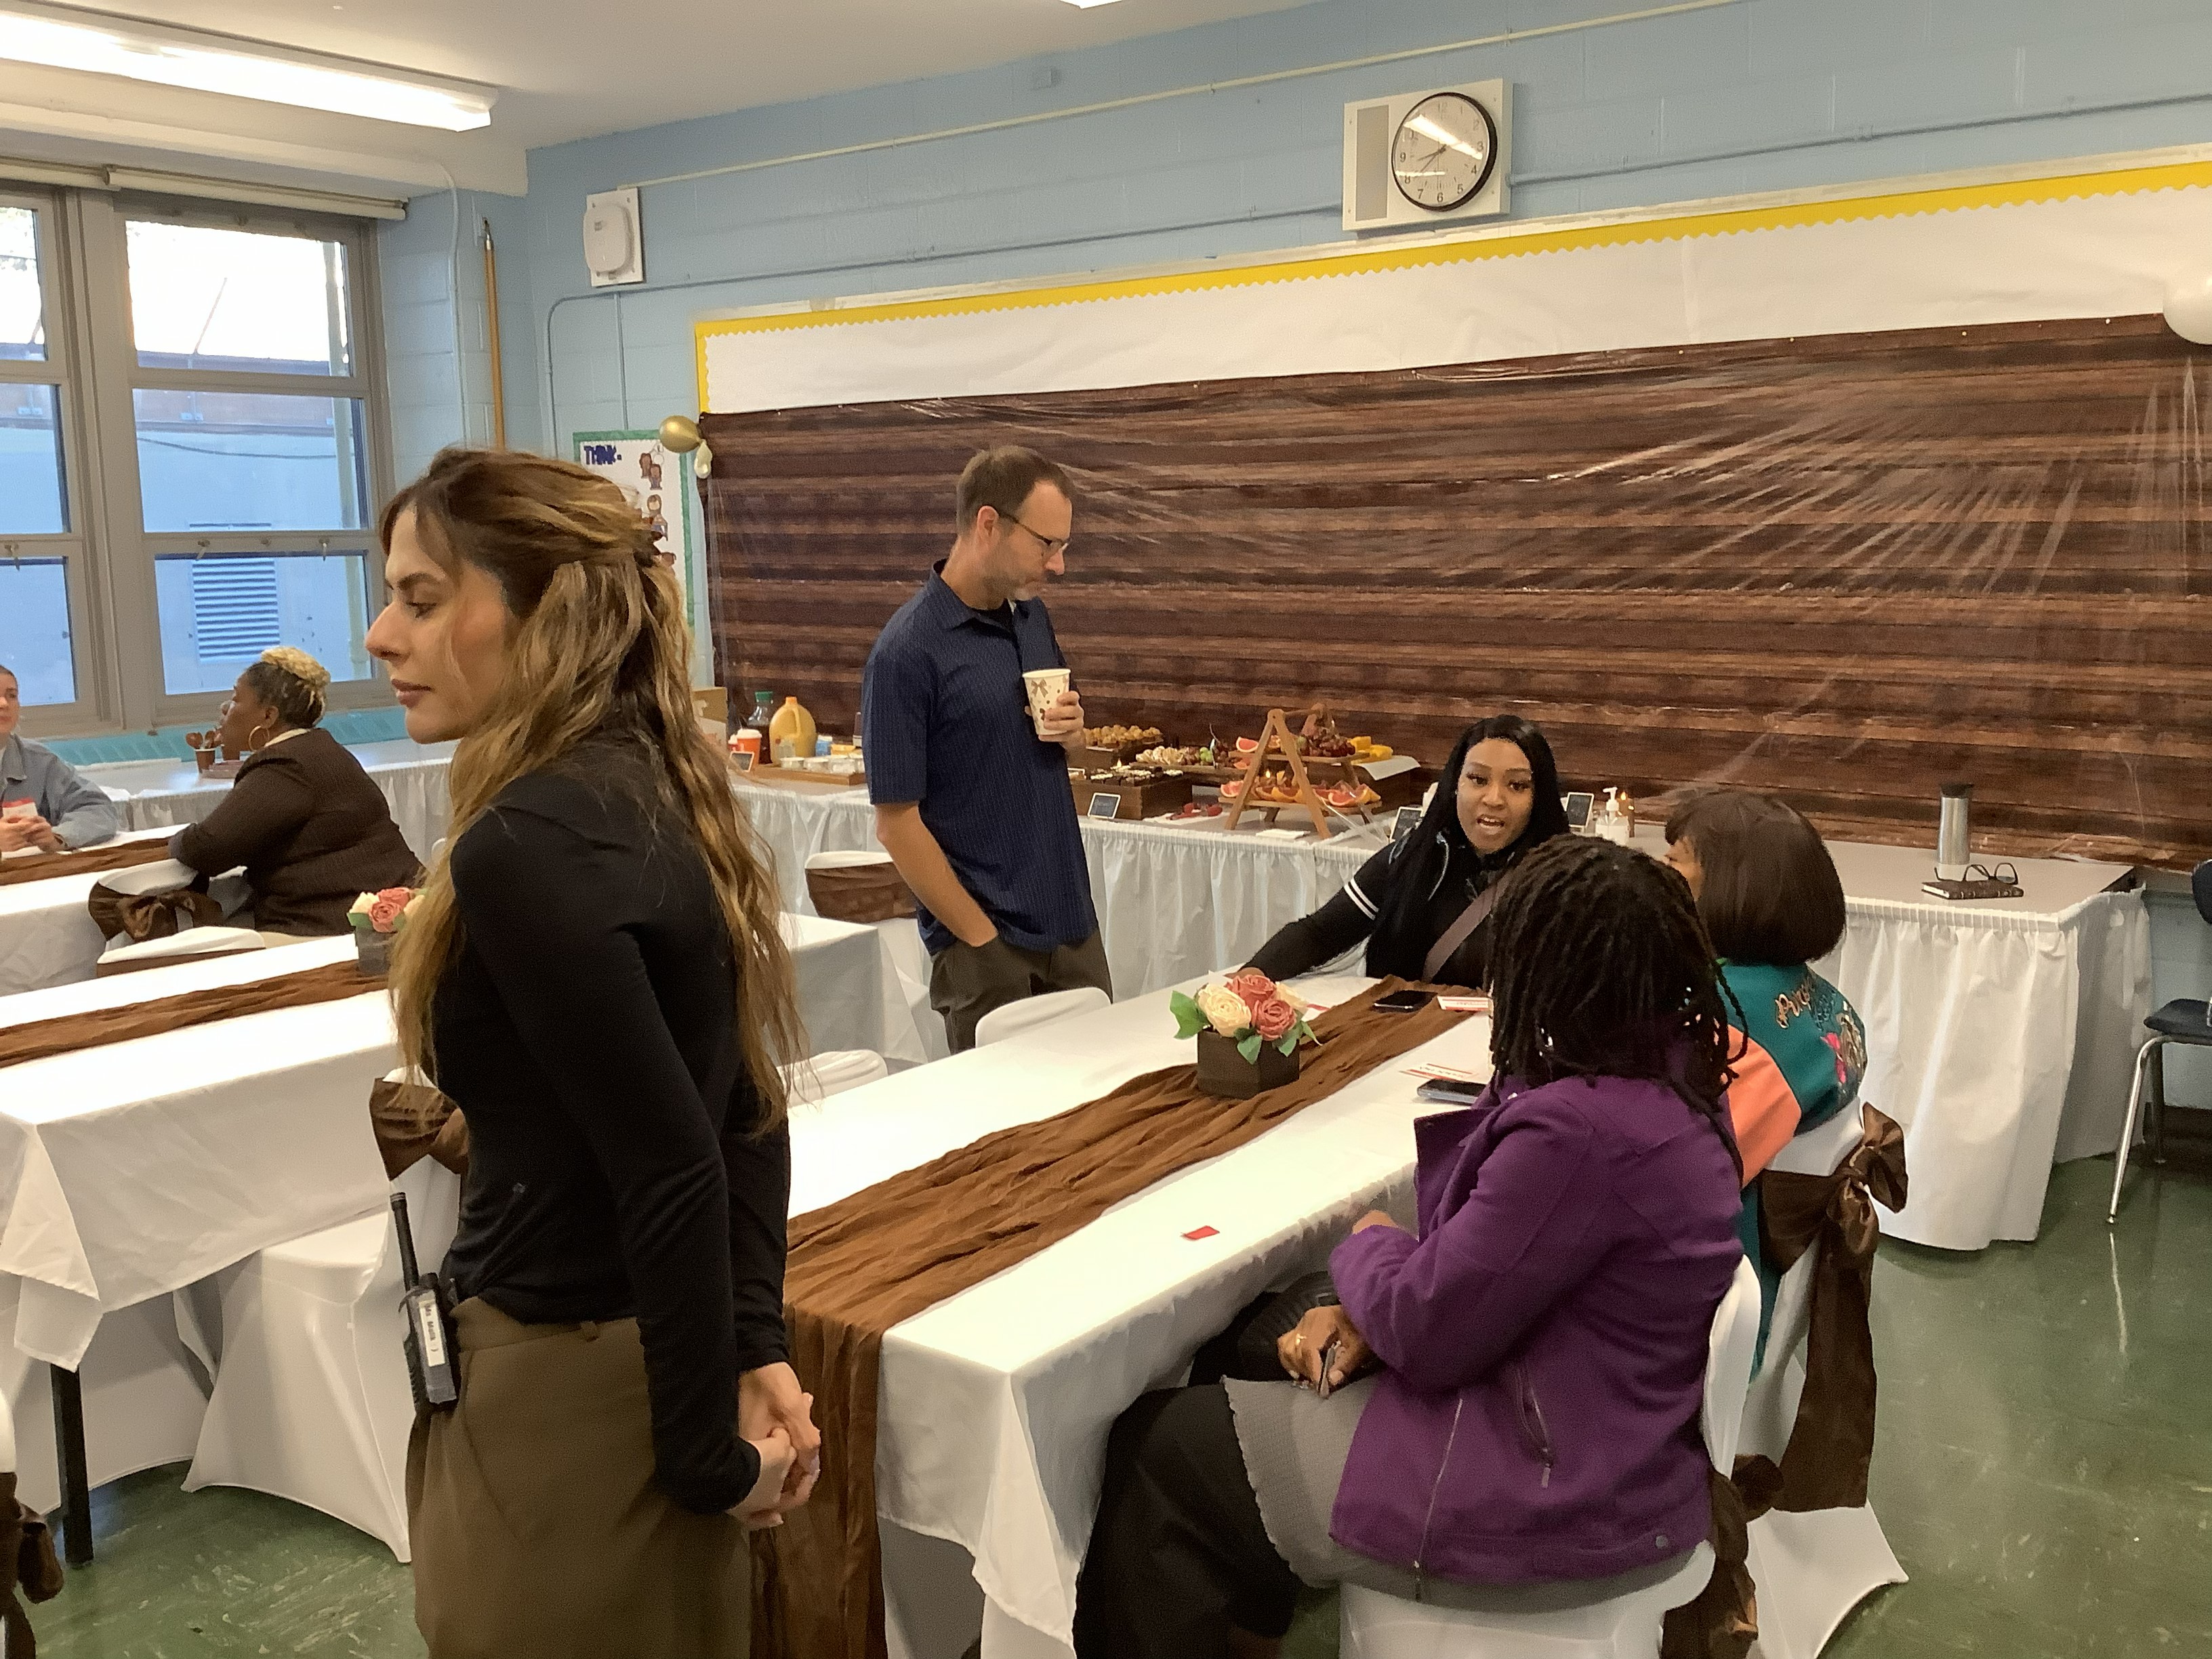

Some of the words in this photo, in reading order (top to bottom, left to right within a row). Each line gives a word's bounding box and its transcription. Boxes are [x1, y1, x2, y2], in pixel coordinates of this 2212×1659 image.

[1473, 120, 1479, 131] 2
[1477, 140, 1483, 152] 3
[1399, 151, 1406, 163] 9
[1471, 164, 1477, 175] 4
[1404, 174, 1411, 184] 8
[1417, 188, 1424, 199] 7
[1457, 183, 1464, 194] 5
[1437, 192, 1443, 203] 6
